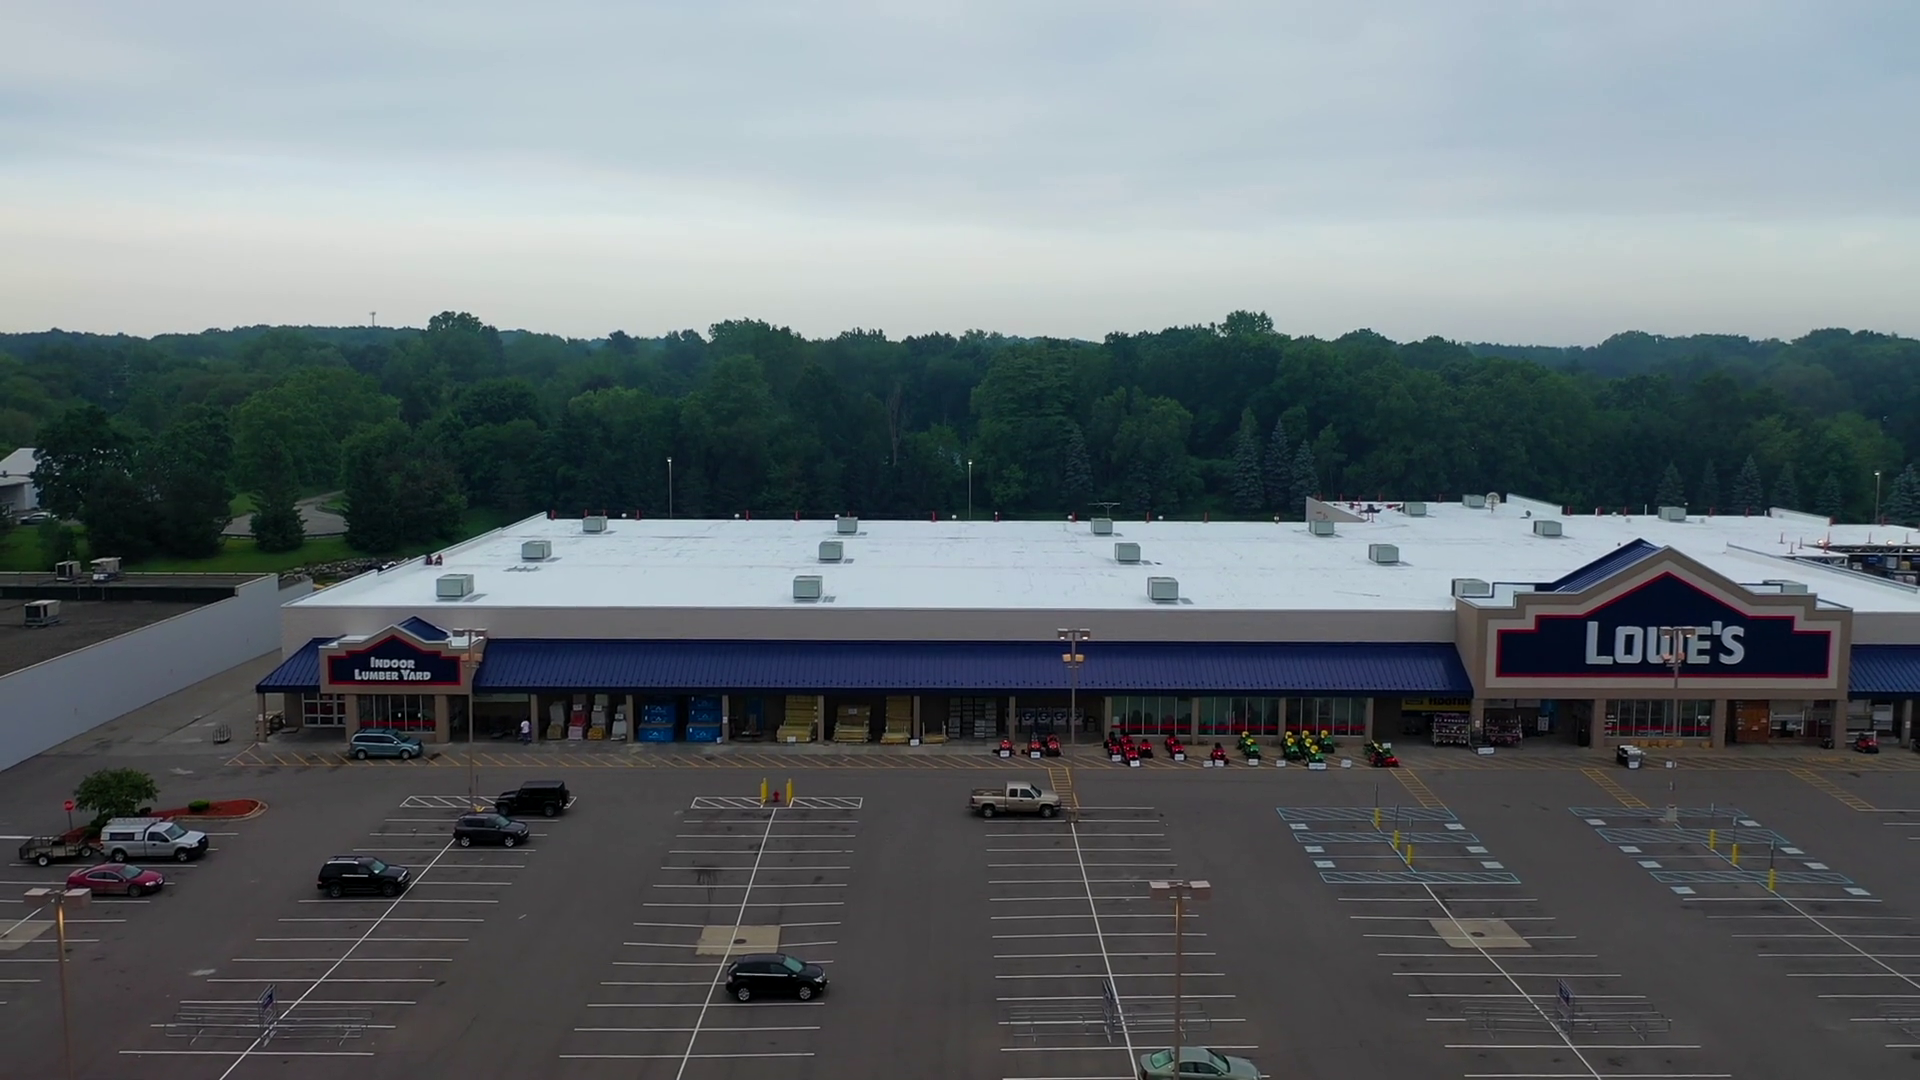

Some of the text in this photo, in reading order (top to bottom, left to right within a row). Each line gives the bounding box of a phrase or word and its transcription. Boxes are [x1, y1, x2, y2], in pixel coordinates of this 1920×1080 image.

[1585, 621, 1745, 665] LOWE'S
[370, 657, 415, 669] INDOOR
[354, 669, 431, 680] LUMBER YARD
